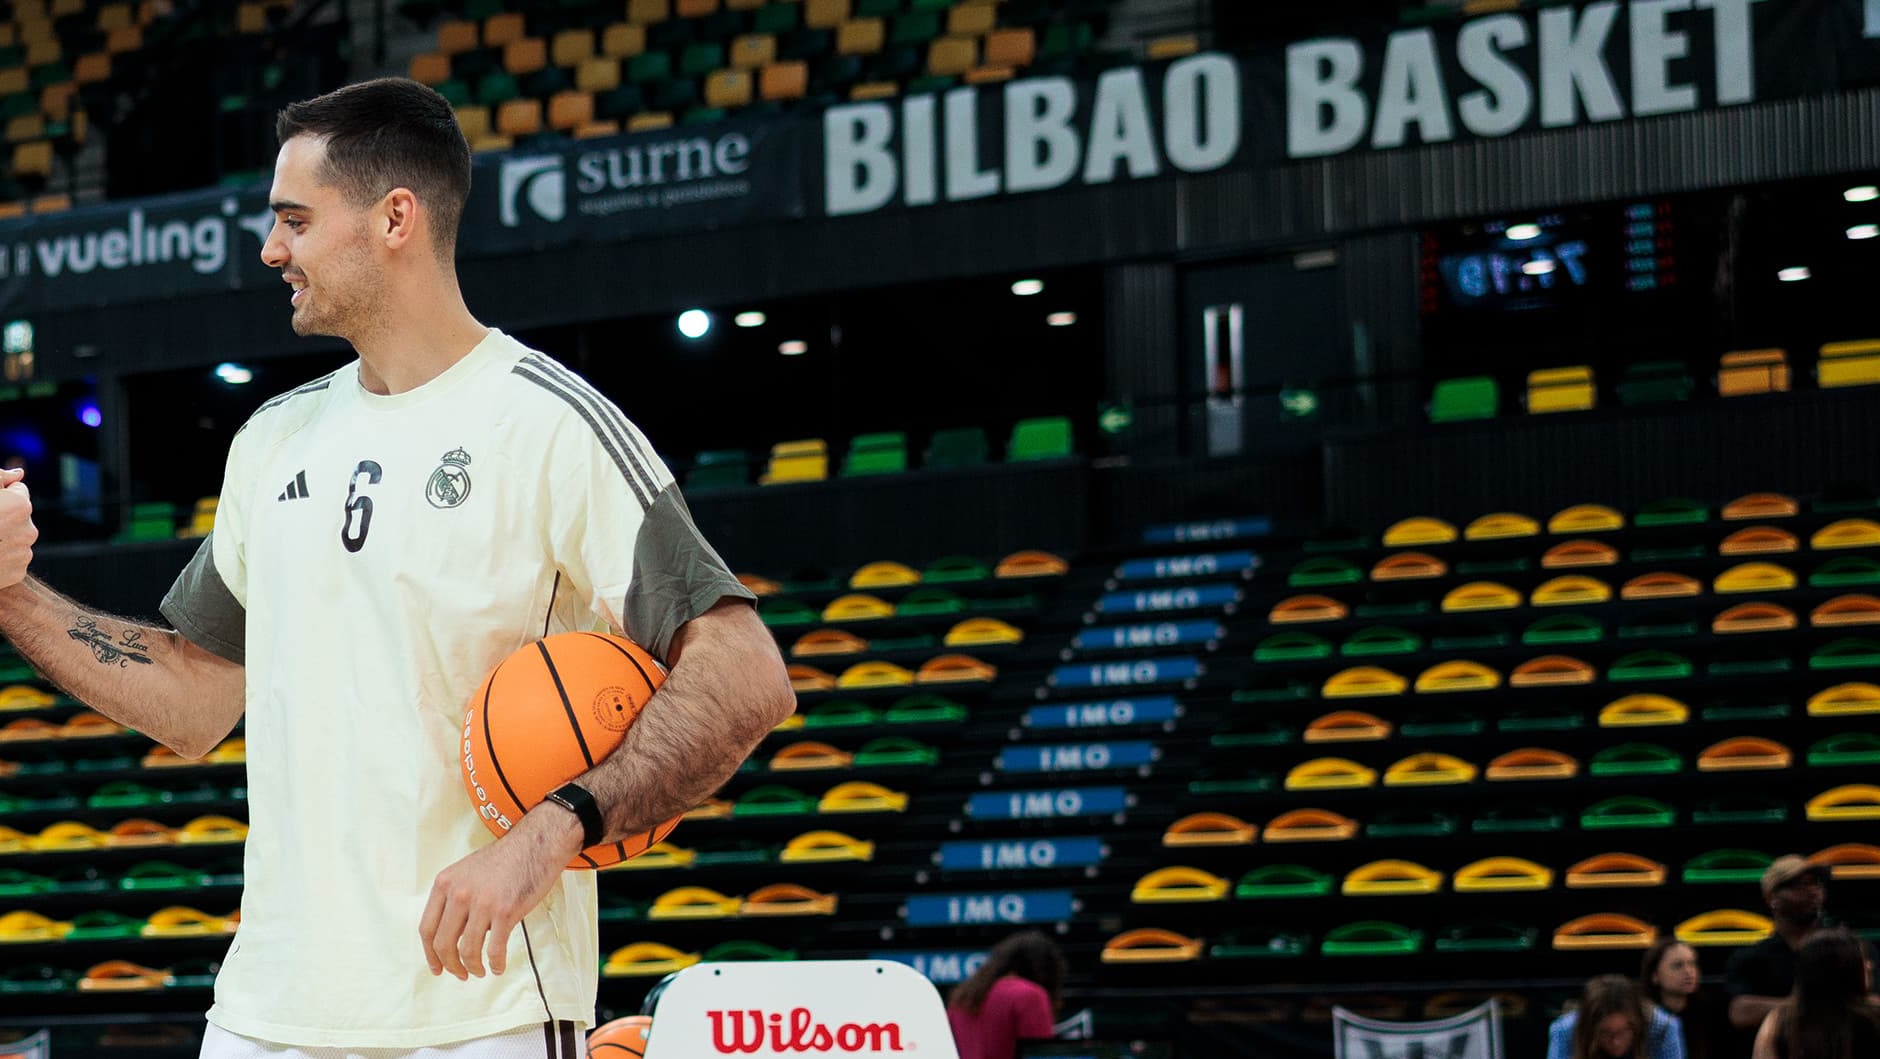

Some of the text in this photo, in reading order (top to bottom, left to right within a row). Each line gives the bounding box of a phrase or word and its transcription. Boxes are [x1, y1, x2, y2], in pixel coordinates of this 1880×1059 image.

[824, 0, 1767, 217] BILBAO BASKET
[577, 131, 750, 194] surne
[36, 206, 228, 277] vueling
[340, 459, 383, 553] 6
[707, 1006, 904, 1054] Wilson
